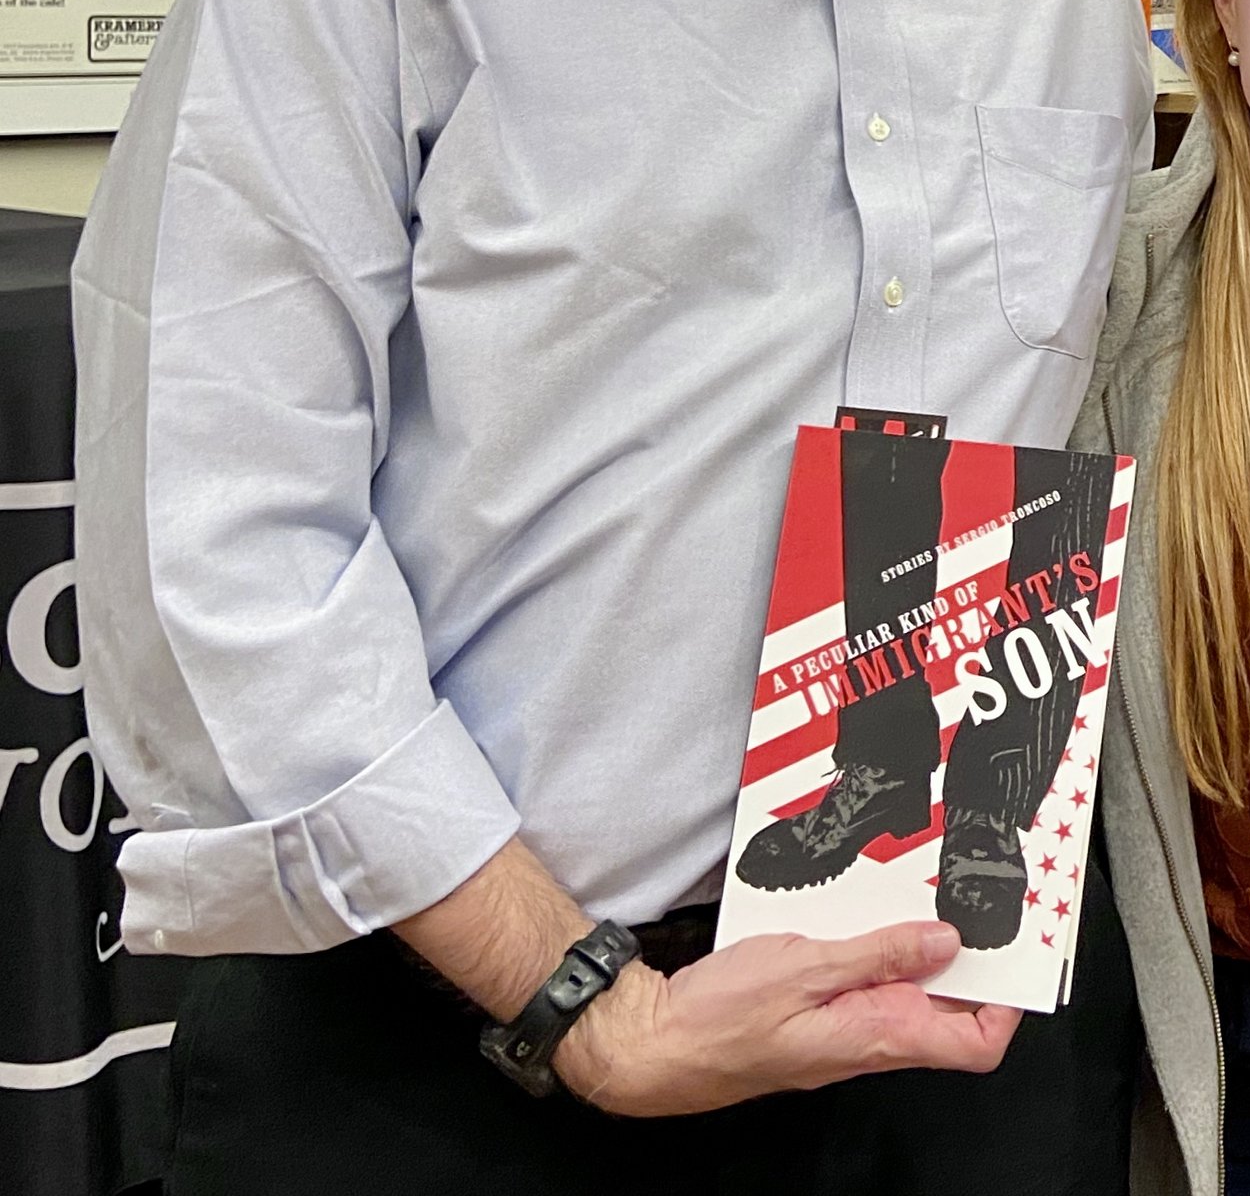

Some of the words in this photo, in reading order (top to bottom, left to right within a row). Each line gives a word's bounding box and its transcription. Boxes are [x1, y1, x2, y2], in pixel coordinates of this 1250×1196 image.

[880, 550, 934, 584] STORIES
[935, 541, 951, 556] BY
[953, 519, 999, 549] SERGIO
[1000, 490, 1062, 524] TRONCOSO
[772, 673, 789, 694] A
[790, 622, 895, 684] PECULIAR
[897, 596, 950, 634] KIND
[954, 580, 979, 605] OF
[801, 551, 1100, 722] IMMIGRANT'S
[955, 597, 1111, 727] SON
